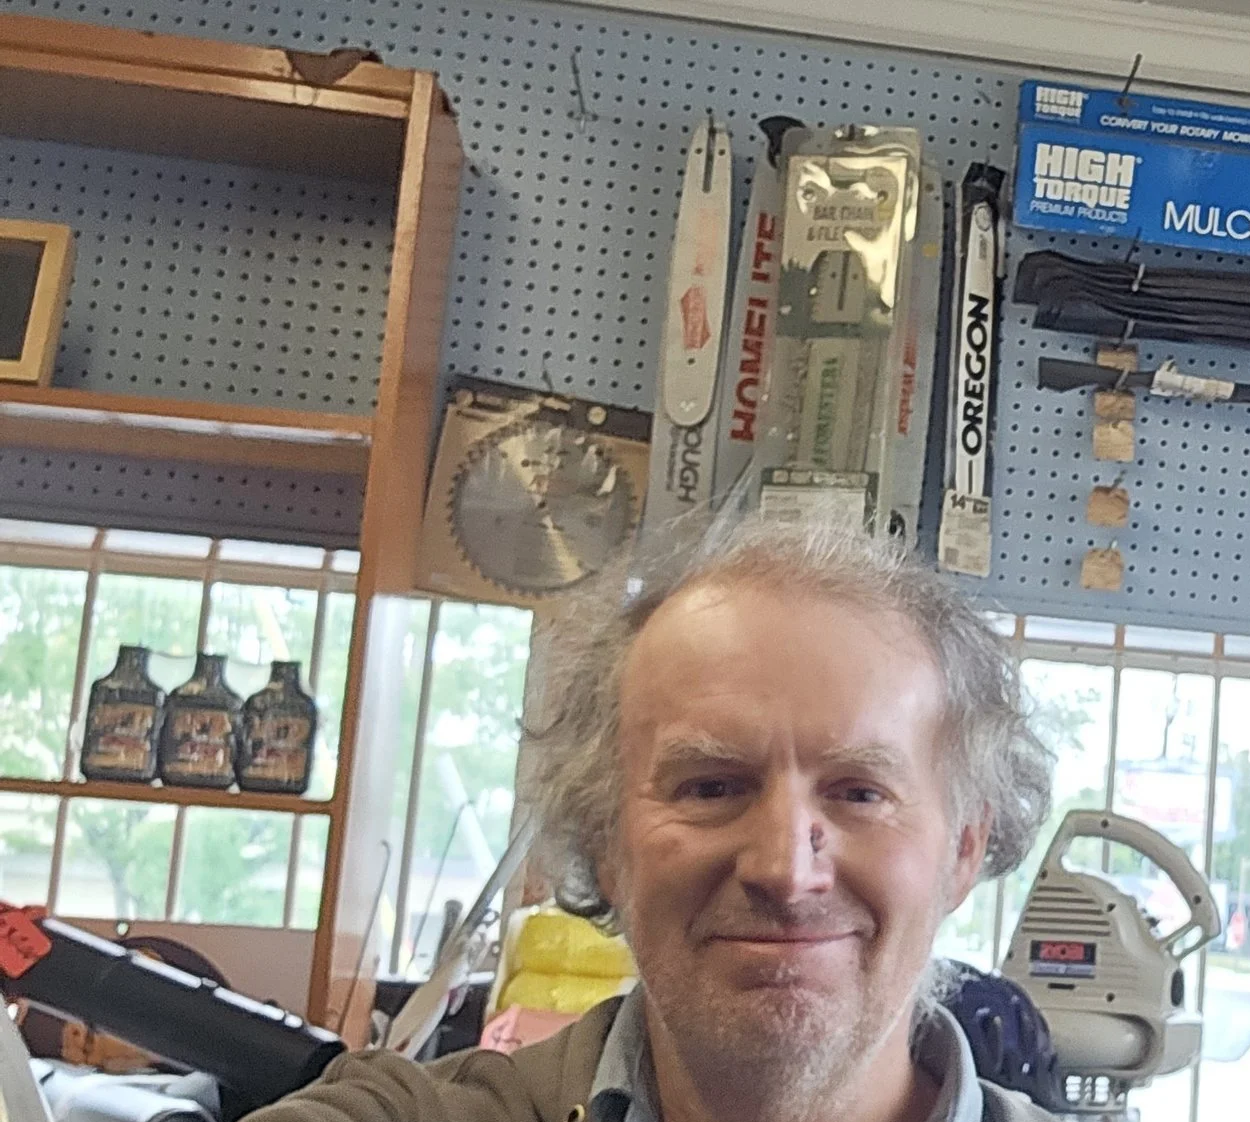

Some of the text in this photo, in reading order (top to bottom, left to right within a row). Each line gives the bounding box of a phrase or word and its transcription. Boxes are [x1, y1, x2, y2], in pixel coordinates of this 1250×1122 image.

[1100, 115, 1149, 132] CONVERT
[1150, 121, 1178, 135] YOUR
[1180, 125, 1219, 140] ROTARY
[1034, 143, 1135, 187] HIGH
[1030, 200, 1128, 224] PREMIUM PRODUCTS
[1033, 177, 1131, 209] TORQUE
[961, 293, 990, 457] OREGON
[678, 425, 702, 503] OUGH
